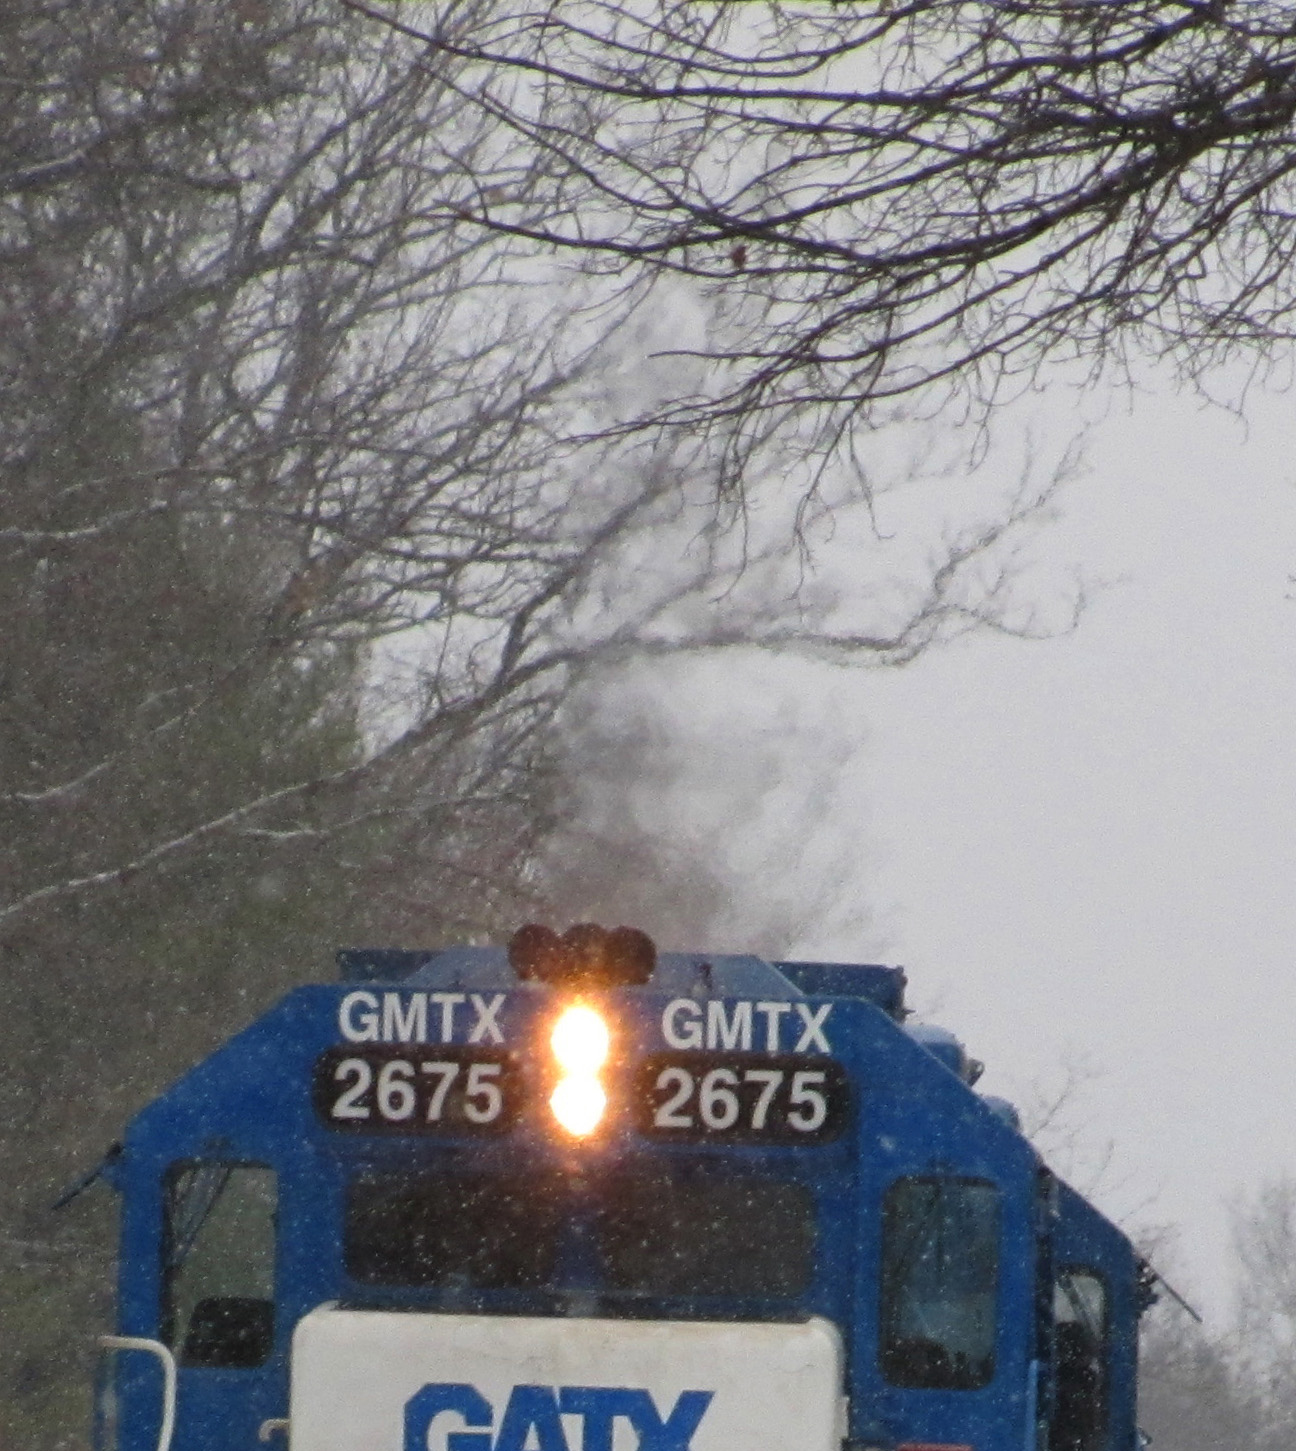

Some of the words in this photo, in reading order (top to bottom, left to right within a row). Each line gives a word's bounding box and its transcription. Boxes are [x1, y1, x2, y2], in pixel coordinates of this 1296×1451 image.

[339, 991, 506, 1044] GMTX
[662, 999, 834, 1053] GMTX
[331, 1060, 503, 1122] 2675
[654, 1069, 829, 1132] 2675
